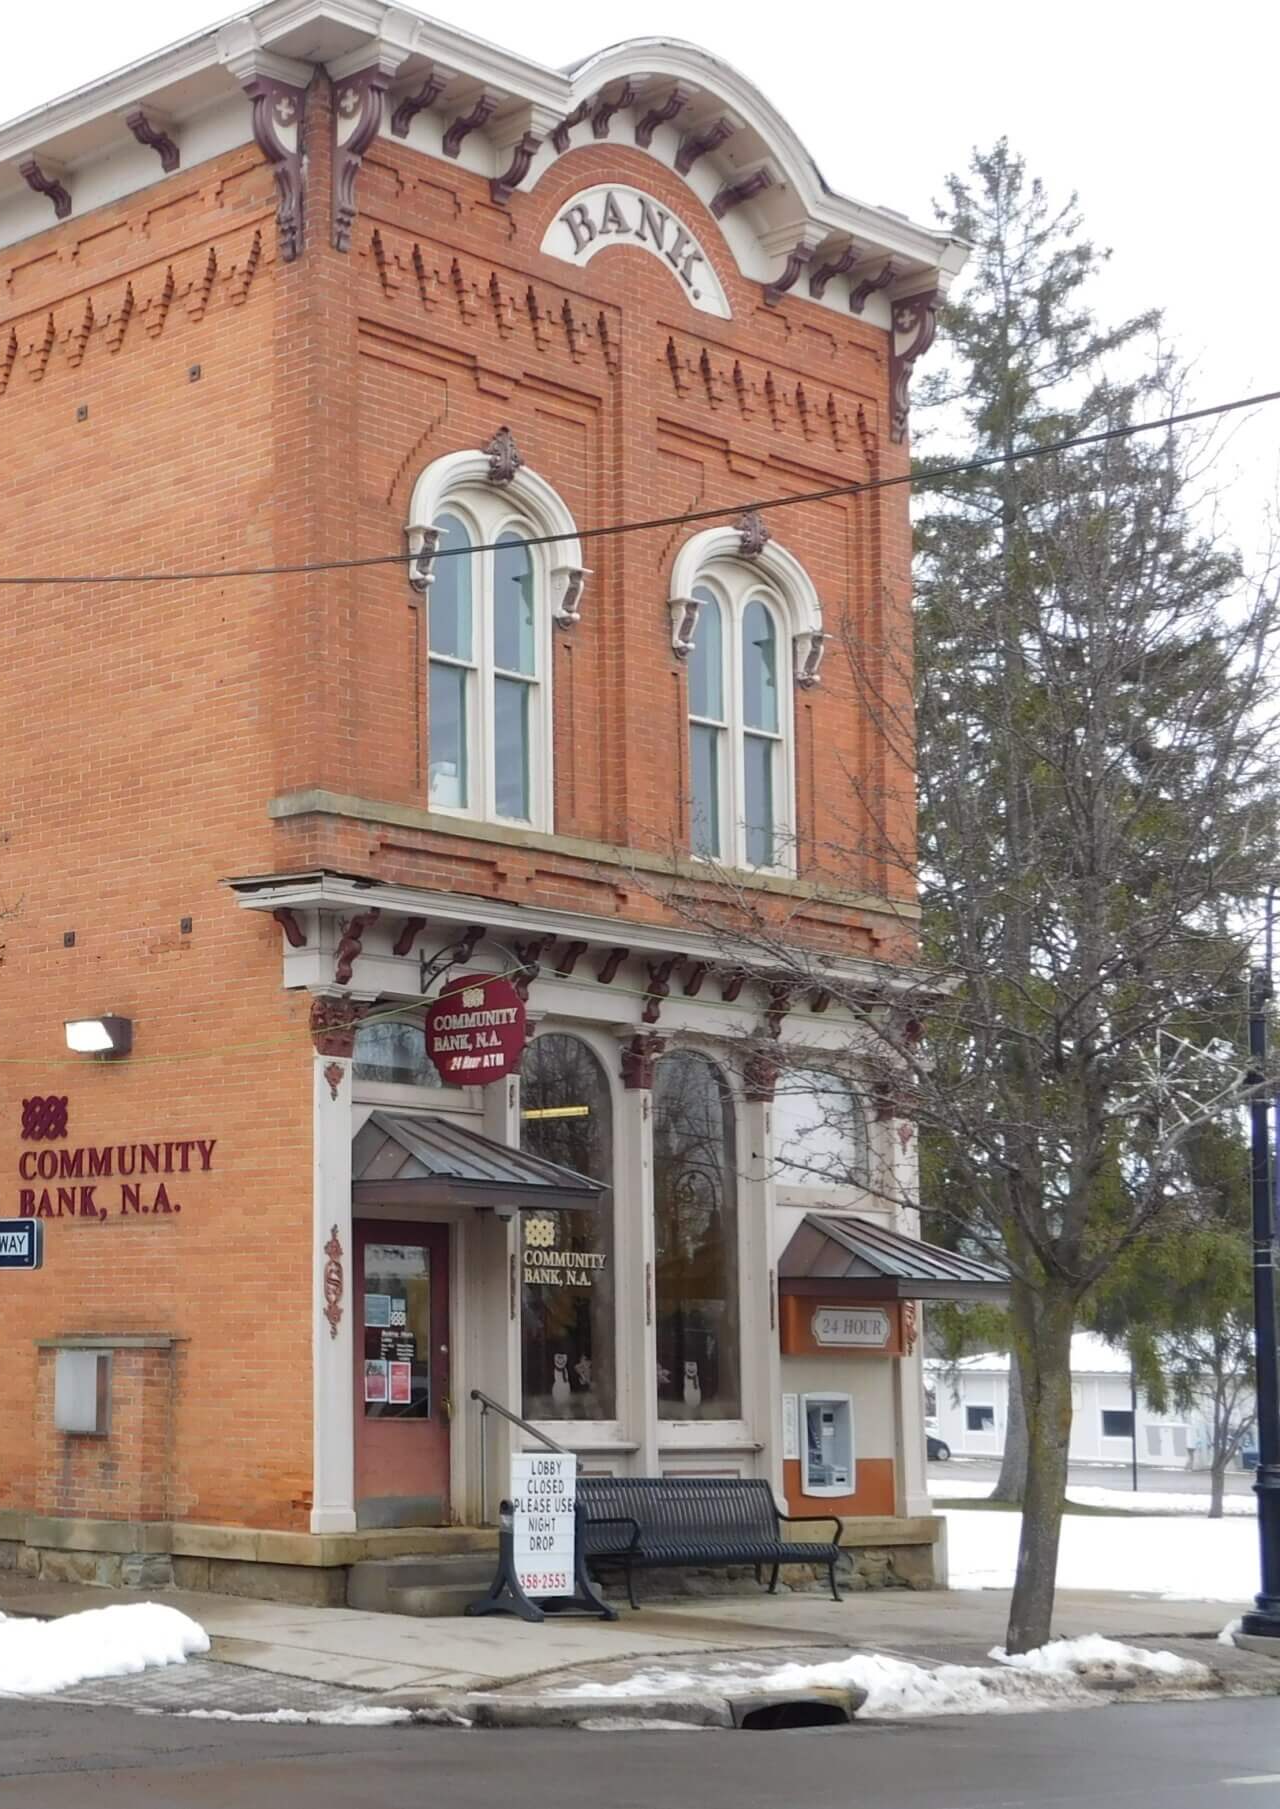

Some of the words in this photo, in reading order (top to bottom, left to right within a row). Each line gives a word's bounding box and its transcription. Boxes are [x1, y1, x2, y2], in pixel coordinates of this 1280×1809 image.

[433, 1007, 518, 1031] COMMUNITY
[433, 1033, 472, 1052] BANK,
[476, 1029, 502, 1048] N.A.
[450, 1057, 462, 1070] 24
[483, 1053, 504, 1067] ATM
[18, 1139, 218, 1181] COMMUNITY
[19, 1185, 108, 1221] BANK,
[120, 1182, 182, 1215] N.A.
[523, 1250, 606, 1269] COMMUNITY
[523, 1268, 563, 1286] BANK,
[566, 1270, 592, 1286] N.A.
[823, 1318, 838, 1334] 24
[843, 1319, 881, 1335] HOUR
[531, 1460, 562, 1475] LOBBY
[527, 1479, 565, 1494] CLOSED
[513, 1498, 554, 1513] PLEASE
[555, 1499, 574, 1513] USE
[528, 1517, 556, 1533] NIGHT
[529, 1536, 555, 1551] DROP
[519, 1575, 567, 1589] 358-2553
